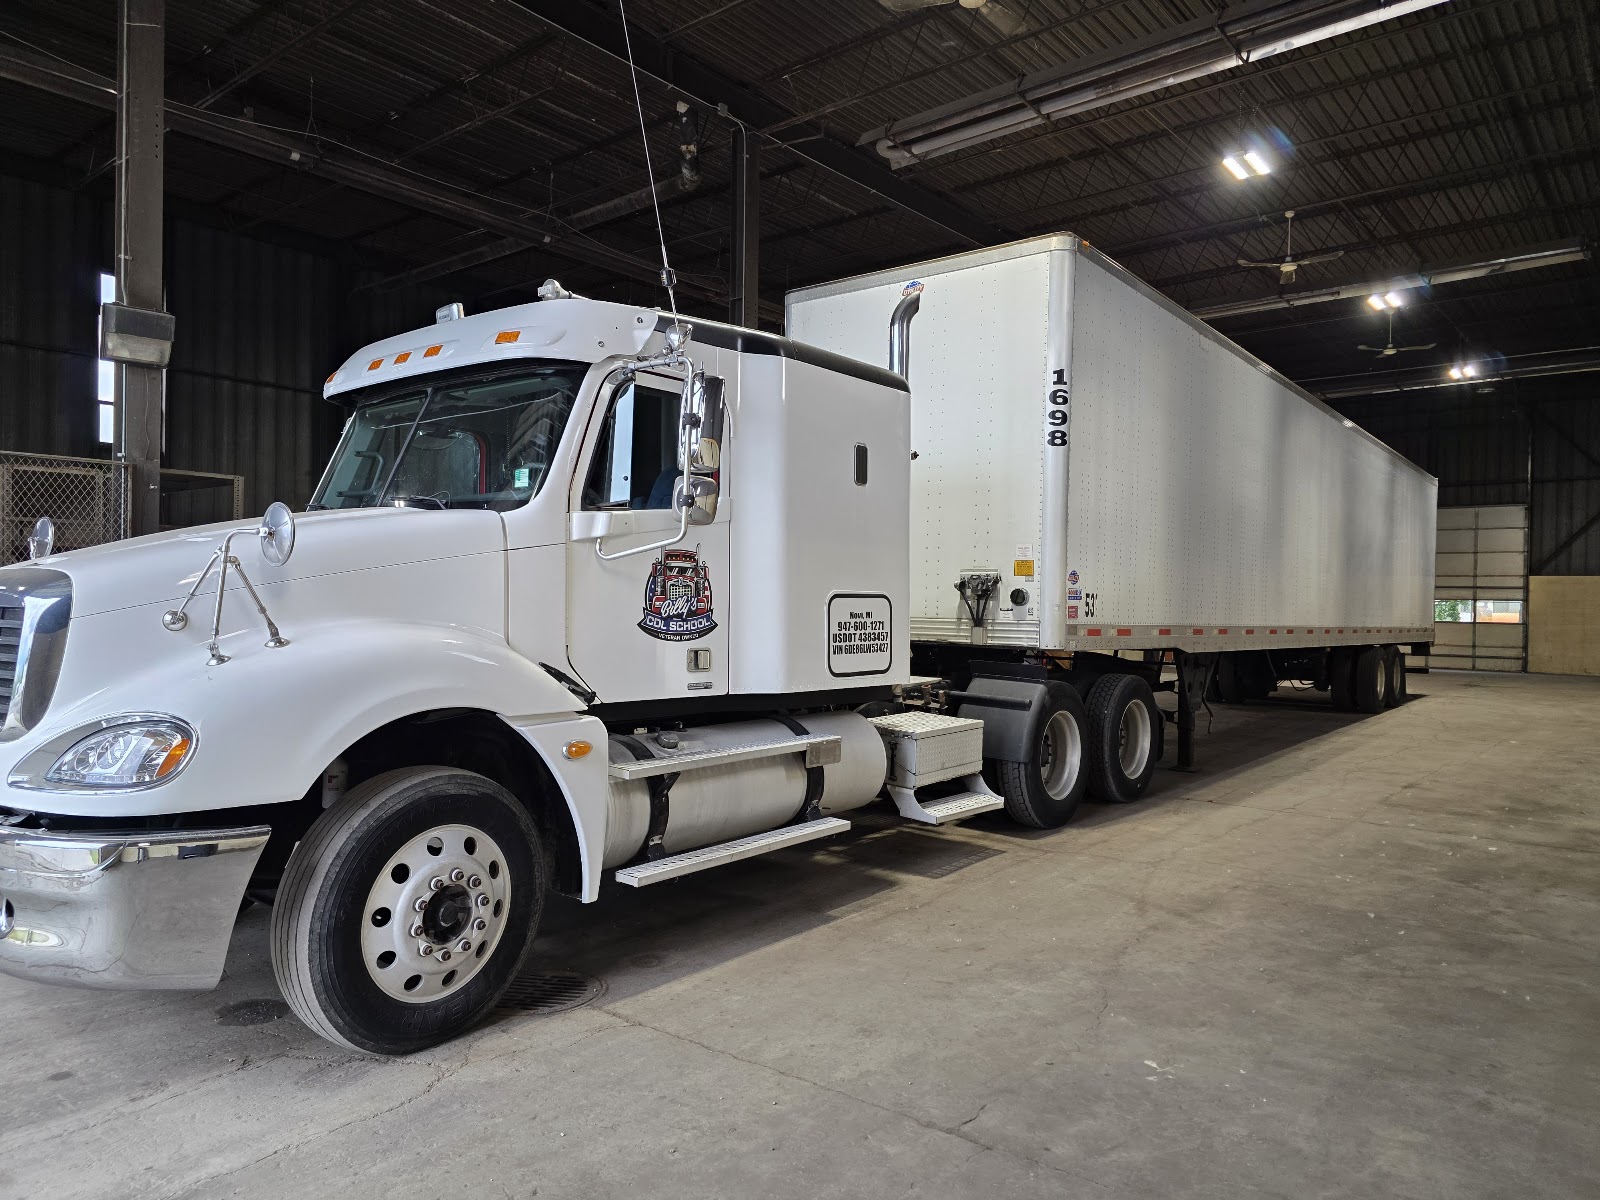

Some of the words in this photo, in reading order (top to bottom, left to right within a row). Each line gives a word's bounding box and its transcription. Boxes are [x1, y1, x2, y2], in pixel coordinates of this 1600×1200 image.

[1047, 368, 1069, 446] 1698
[660, 595, 698, 618] Billy's
[865, 611, 873, 619] MI
[646, 616, 667, 630] CDL
[669, 618, 711, 631] SCHOOL
[837, 621, 884, 631] 947-600-1271
[832, 632, 857, 643] USDOT
[858, 631, 889, 642] 4383457
[832, 644, 843, 655] VIN
